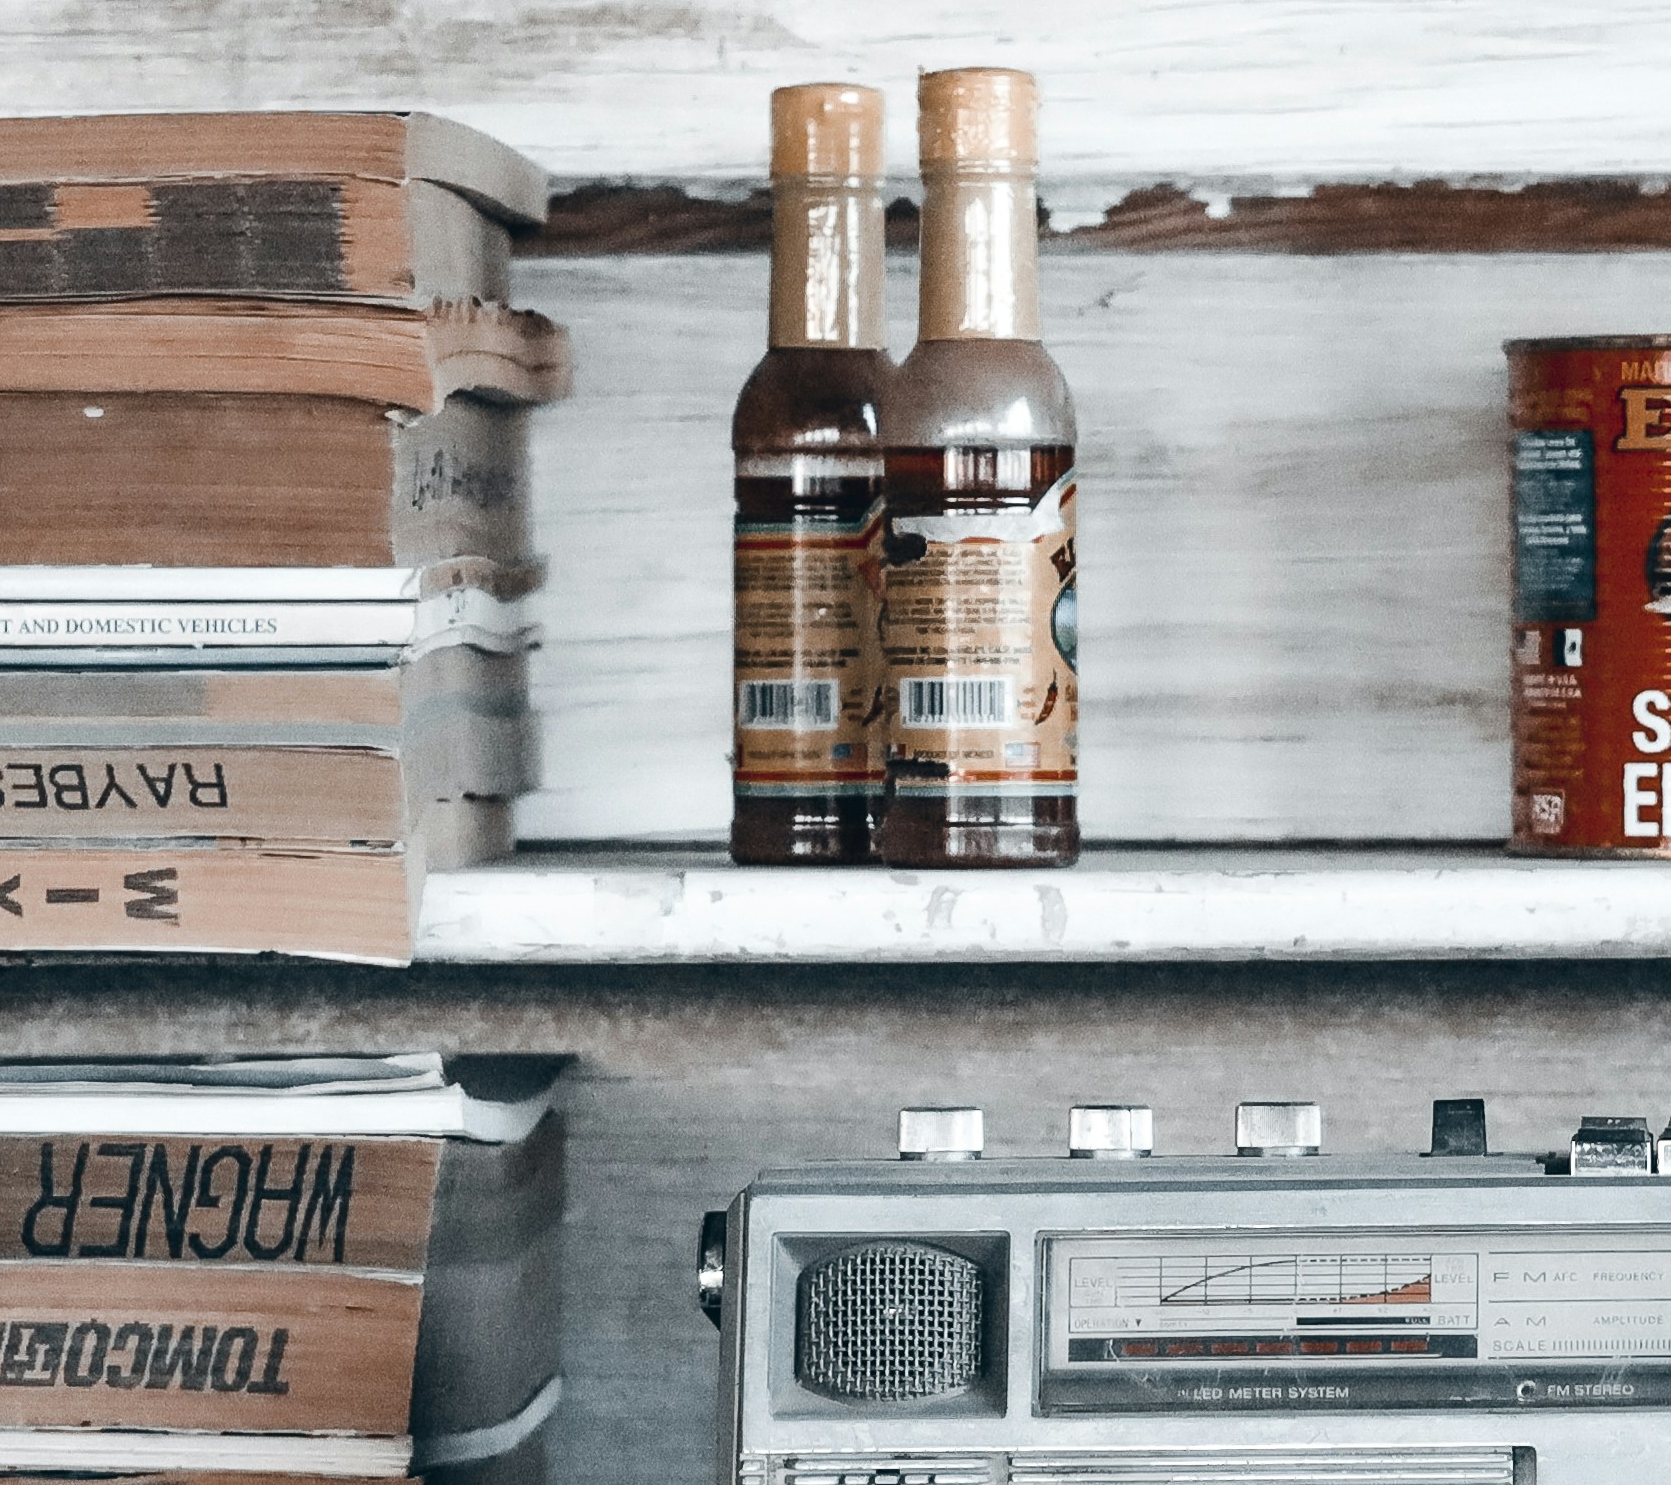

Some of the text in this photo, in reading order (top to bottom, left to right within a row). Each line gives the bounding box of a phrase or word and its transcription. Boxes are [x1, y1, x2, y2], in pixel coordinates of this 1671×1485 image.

[18, 617, 60, 635] AND
[65, 617, 172, 635] DOMESTIC
[178, 616, 279, 635] VEHICLES
[19, 1142, 356, 1265] WAGNER
[1552, 1271, 1577, 1283] AFC
[1591, 1270, 1664, 1283] FREQUENCY
[54, 1320, 292, 1395] TOMCO
[1191, 1385, 1351, 1402] LED METER SYSTEM
